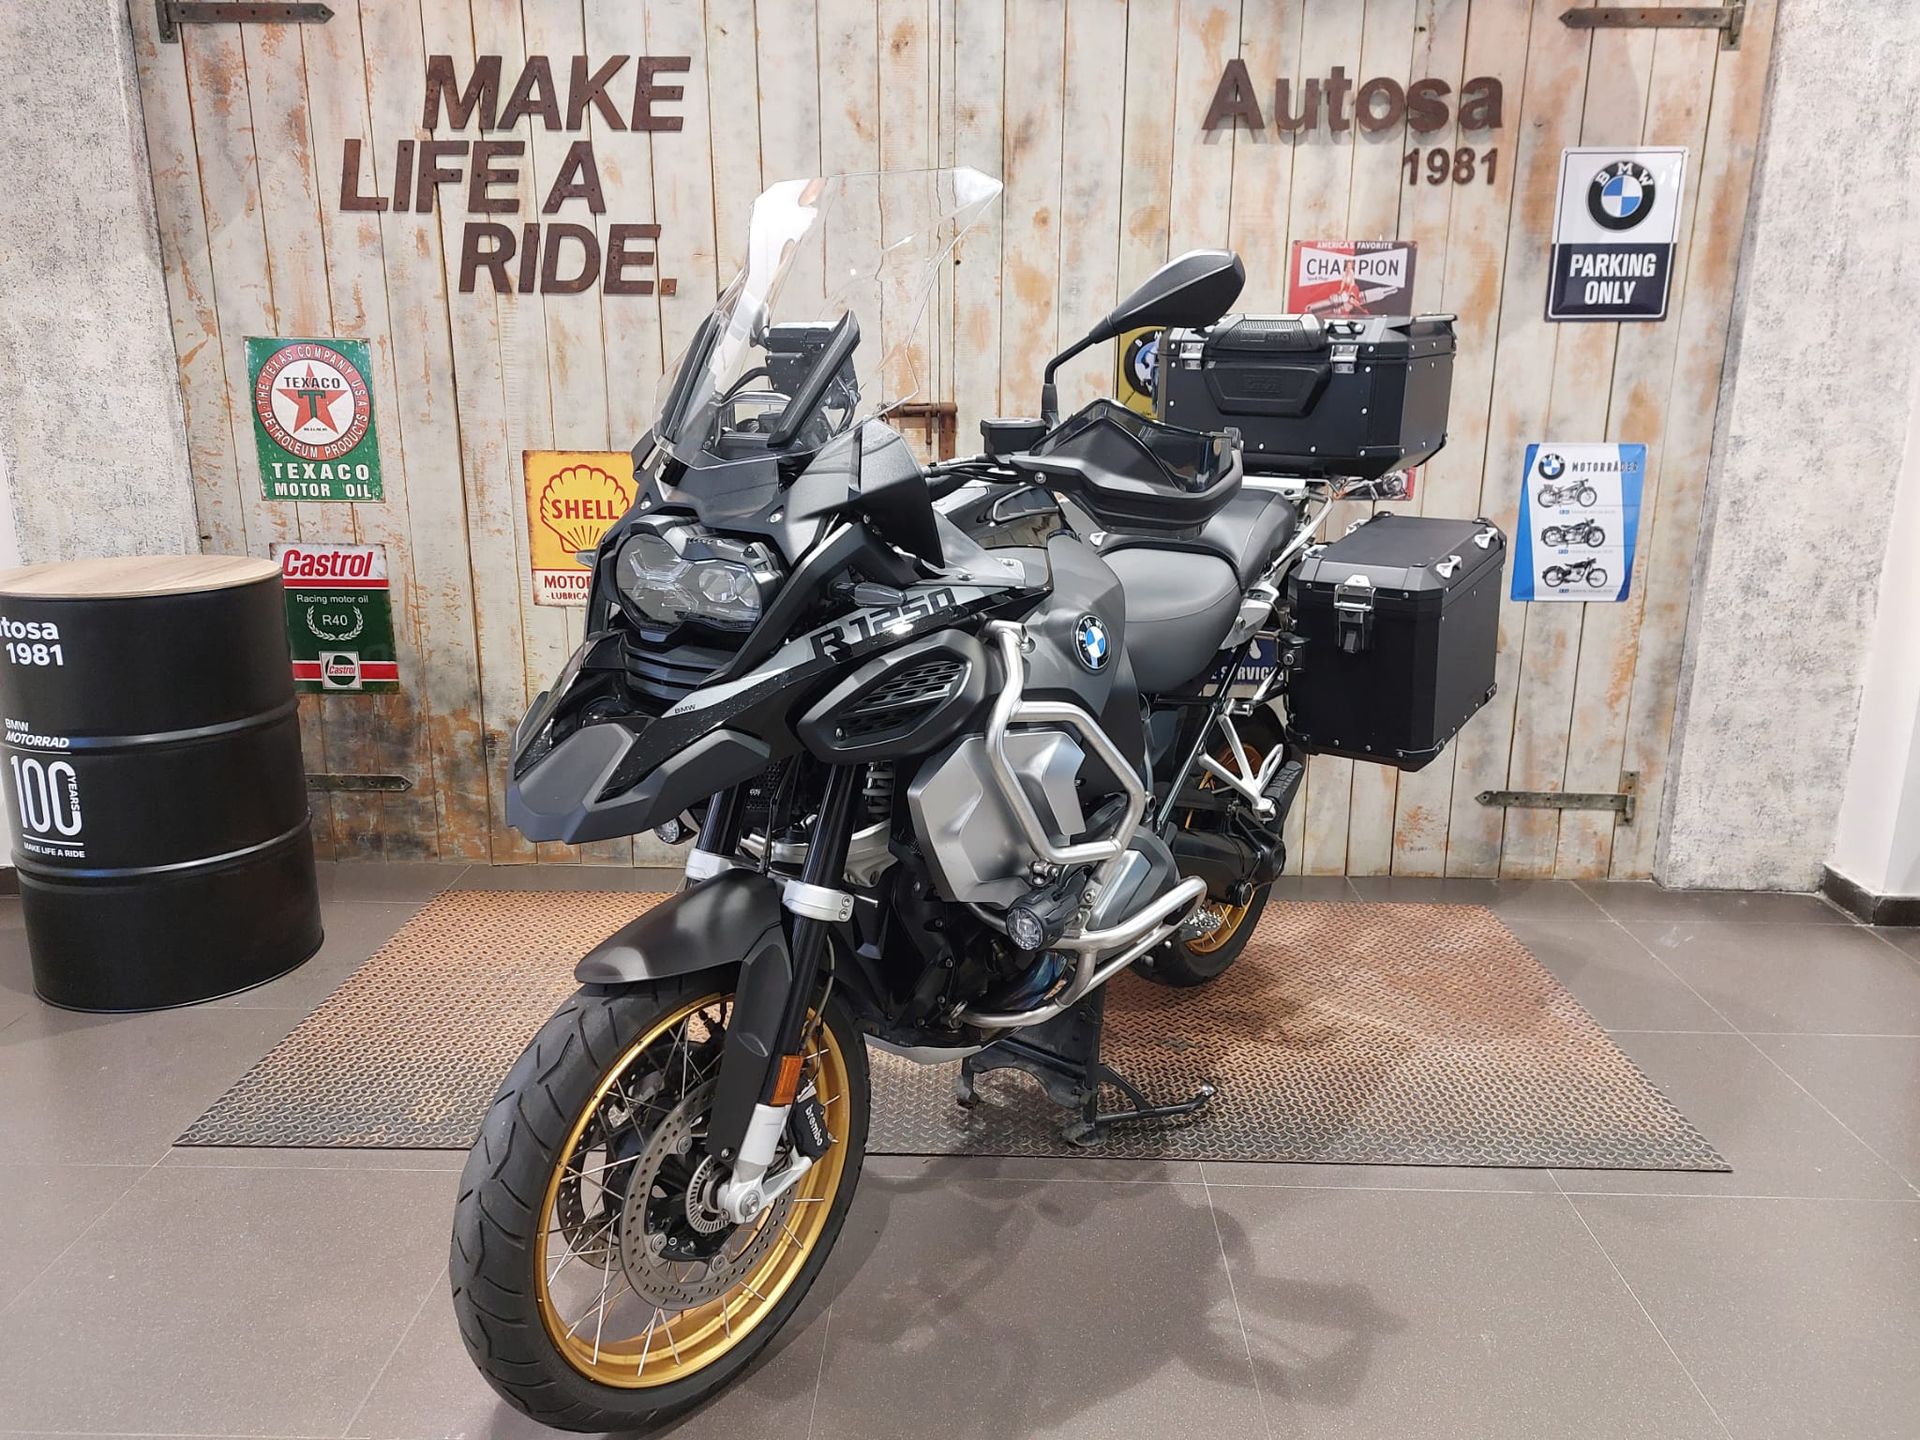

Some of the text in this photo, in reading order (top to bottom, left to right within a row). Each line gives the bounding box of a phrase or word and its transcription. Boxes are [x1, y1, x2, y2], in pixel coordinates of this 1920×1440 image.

[422, 55, 691, 131] MAKE
[1201, 59, 1503, 133] Autosa
[340, 139, 607, 214] LIFE A
[1402, 147, 1498, 186] 1981
[1596, 162, 1654, 187] BMW
[1357, 242, 1393, 250] FAVORITE
[458, 222, 677, 295] RIDE.
[1569, 253, 1657, 278] PARKING
[1584, 281, 1637, 305] ONLY
[262, 349, 293, 379] TEXAS
[297, 346, 353, 374] COMPANY
[258, 383, 270, 405] THE
[284, 376, 341, 389] TEXACO
[297, 389, 326, 418] T
[261, 411, 368, 459] PETROLEUM PRODUCTS
[272, 463, 370, 480] TEXACO
[274, 483, 372, 498] MOTOR OIL
[551, 499, 619, 520] SHELL
[283, 549, 373, 577] Castrol
[296, 594, 369, 605] Racing motor oil
[551, 592, 588, 600] LUBRICA
[0, 616, 60, 640] tosa
[322, 615, 348, 626] R40
[6, 642, 64, 666] 1981
[328, 665, 356, 675] Castrol
[674, 704, 696, 714] BMW
[5, 718, 29, 732] BMW
[5, 731, 70, 748] MOTORRAD
[10, 755, 82, 836] 100
[66, 775, 81, 812] YEARS
[23, 842, 85, 858] MAKE LIFE A RIDE
[805, 1104, 823, 1146] brembo
